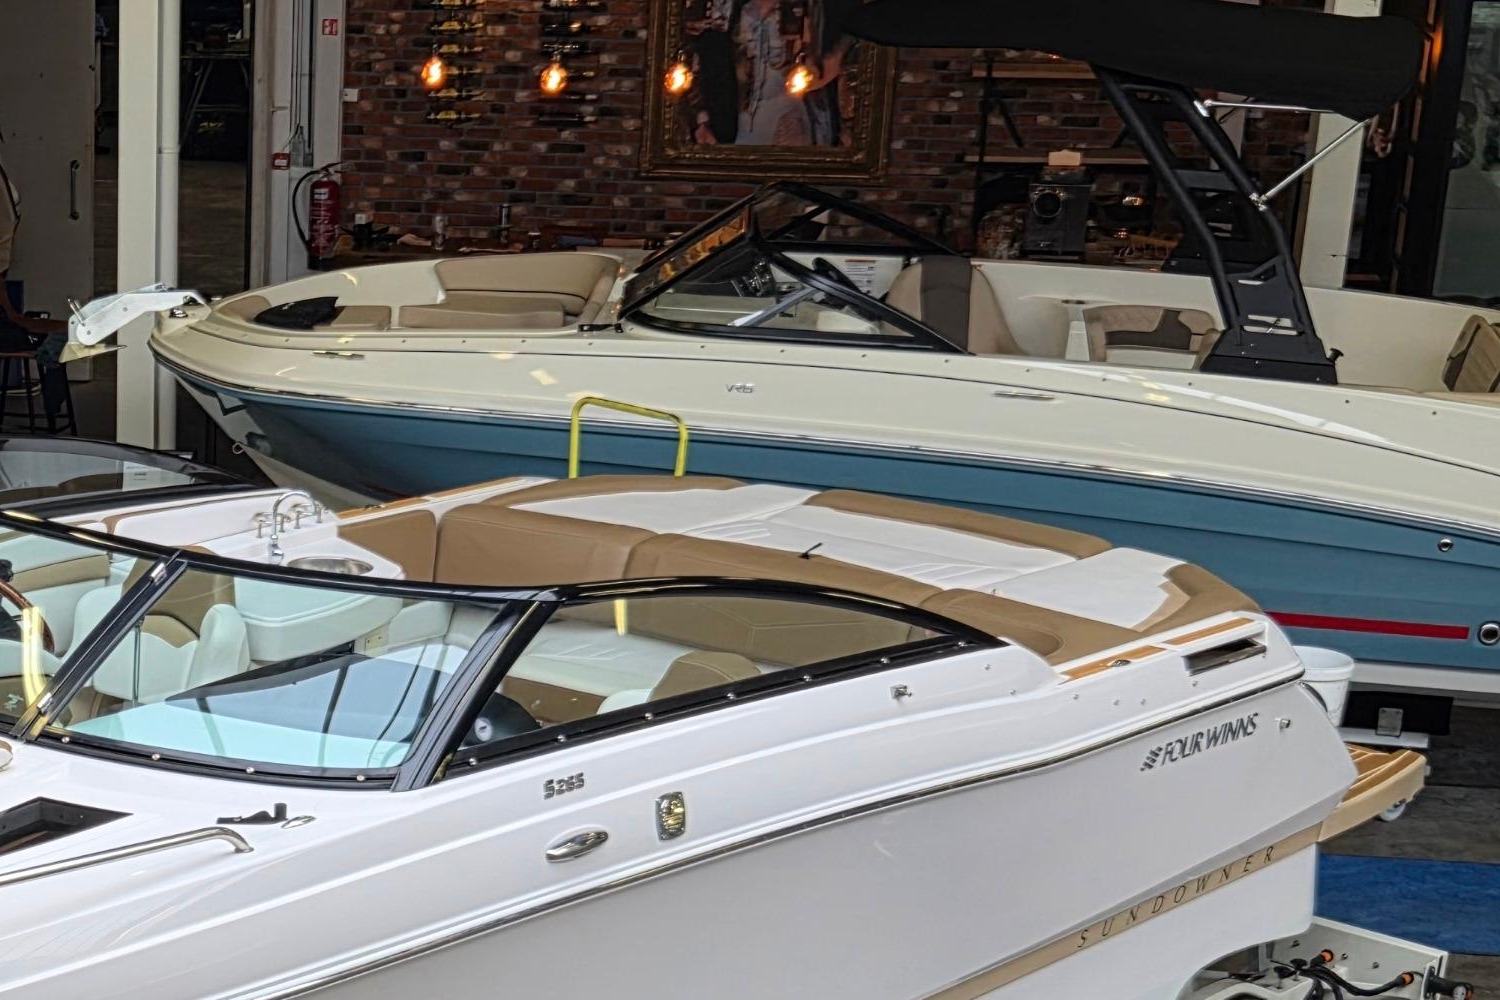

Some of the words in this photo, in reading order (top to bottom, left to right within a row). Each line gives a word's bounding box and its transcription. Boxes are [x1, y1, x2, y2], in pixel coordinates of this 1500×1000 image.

[1160, 731, 1204, 766] FOUR
[1205, 712, 1259, 750] WINNS
[1077, 846, 1274, 948] SUNDOWNER
